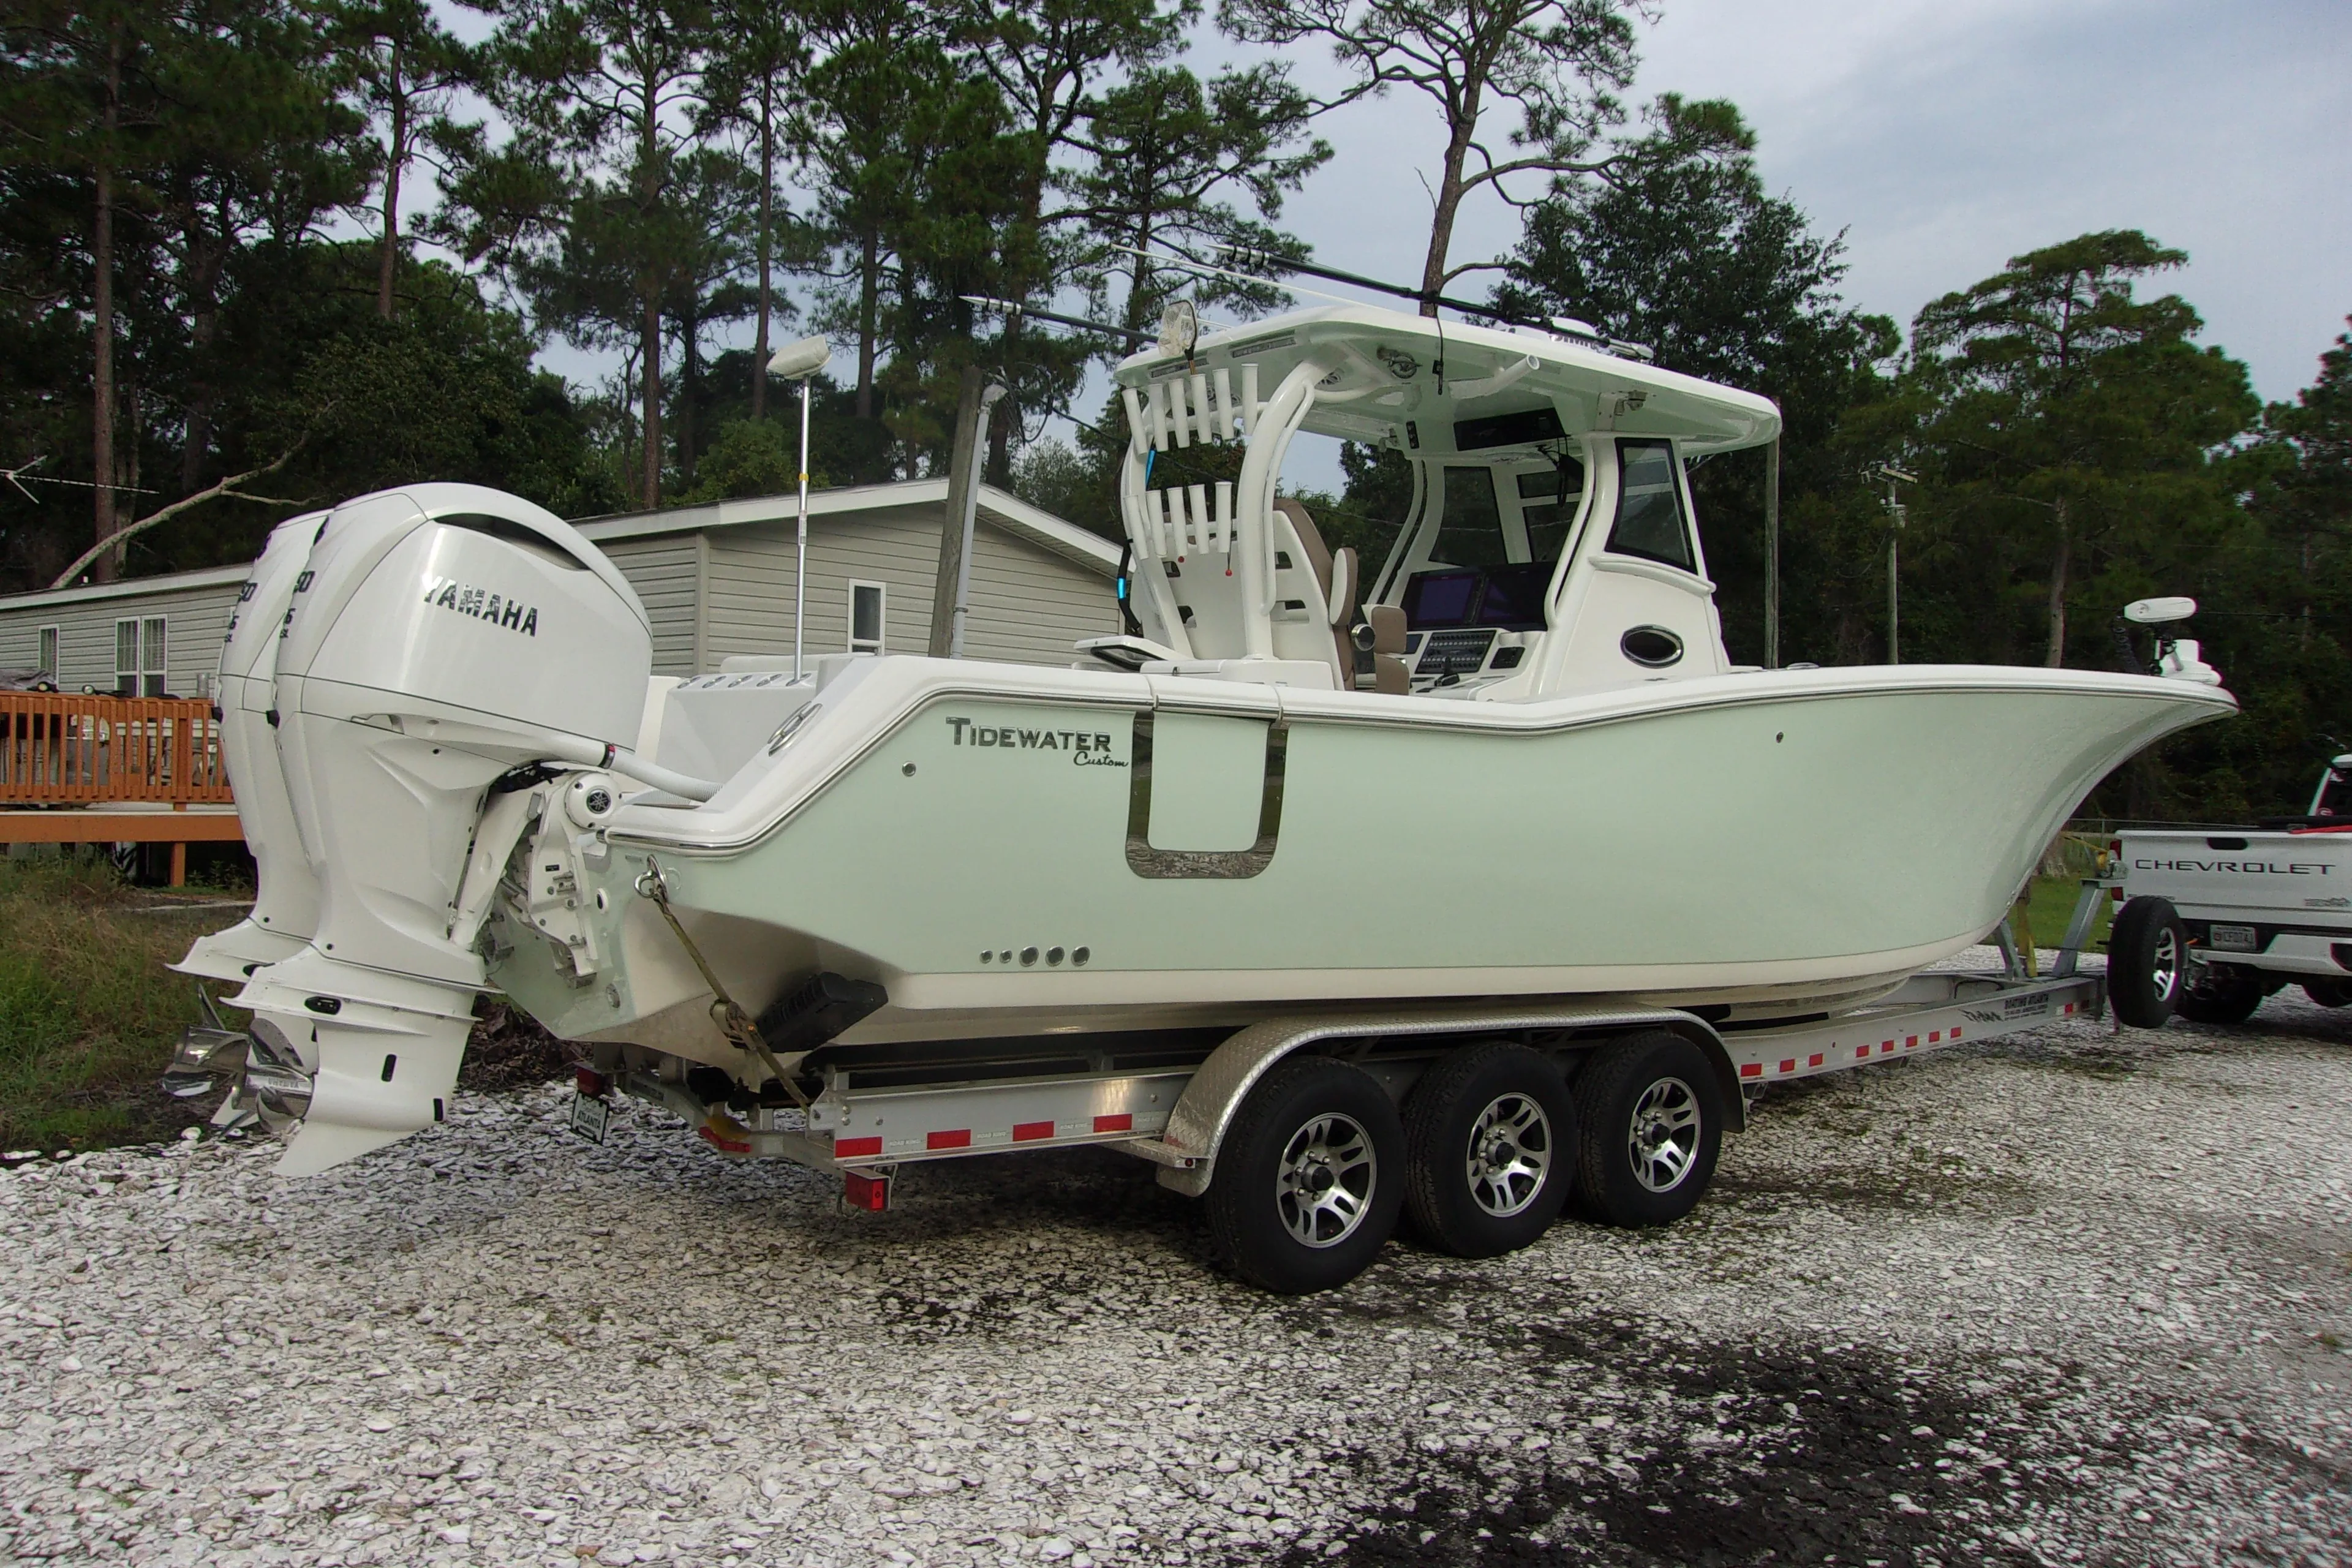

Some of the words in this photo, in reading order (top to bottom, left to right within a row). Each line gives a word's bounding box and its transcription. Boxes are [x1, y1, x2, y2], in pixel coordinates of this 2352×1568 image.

[422, 573, 538, 637] YAMAHA
[946, 717, 1112, 752] TIDEWATER
[1073, 751, 1129, 767] Custom
[2135, 859, 2336, 875] CHEVROLET
[576, 1109, 601, 1129] ATLANTA
